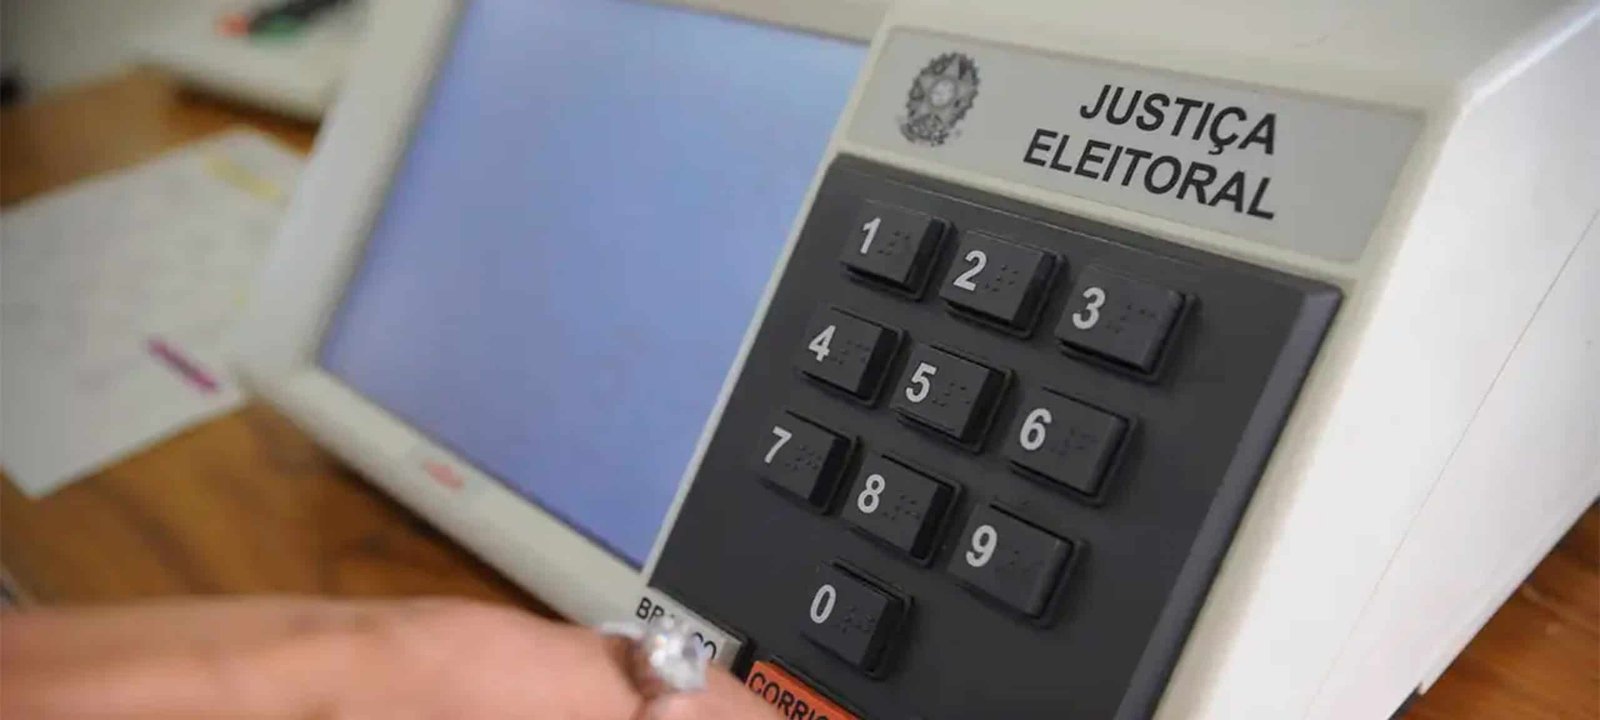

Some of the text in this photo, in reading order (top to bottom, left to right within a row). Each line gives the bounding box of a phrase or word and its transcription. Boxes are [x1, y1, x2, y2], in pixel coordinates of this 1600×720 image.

[1079, 84, 1277, 155] JUSTIÇA
[1023, 128, 1276, 221] ELEITORAL
[860, 217, 882, 254] 1
[953, 249, 987, 291] 2
[1072, 286, 1106, 330] 3
[808, 325, 836, 362] 4
[905, 362, 937, 403] 5
[764, 426, 792, 464] 7
[1019, 408, 1052, 451] 6
[857, 473, 886, 514] 8
[965, 524, 998, 567] 9
[810, 584, 837, 624] 0
